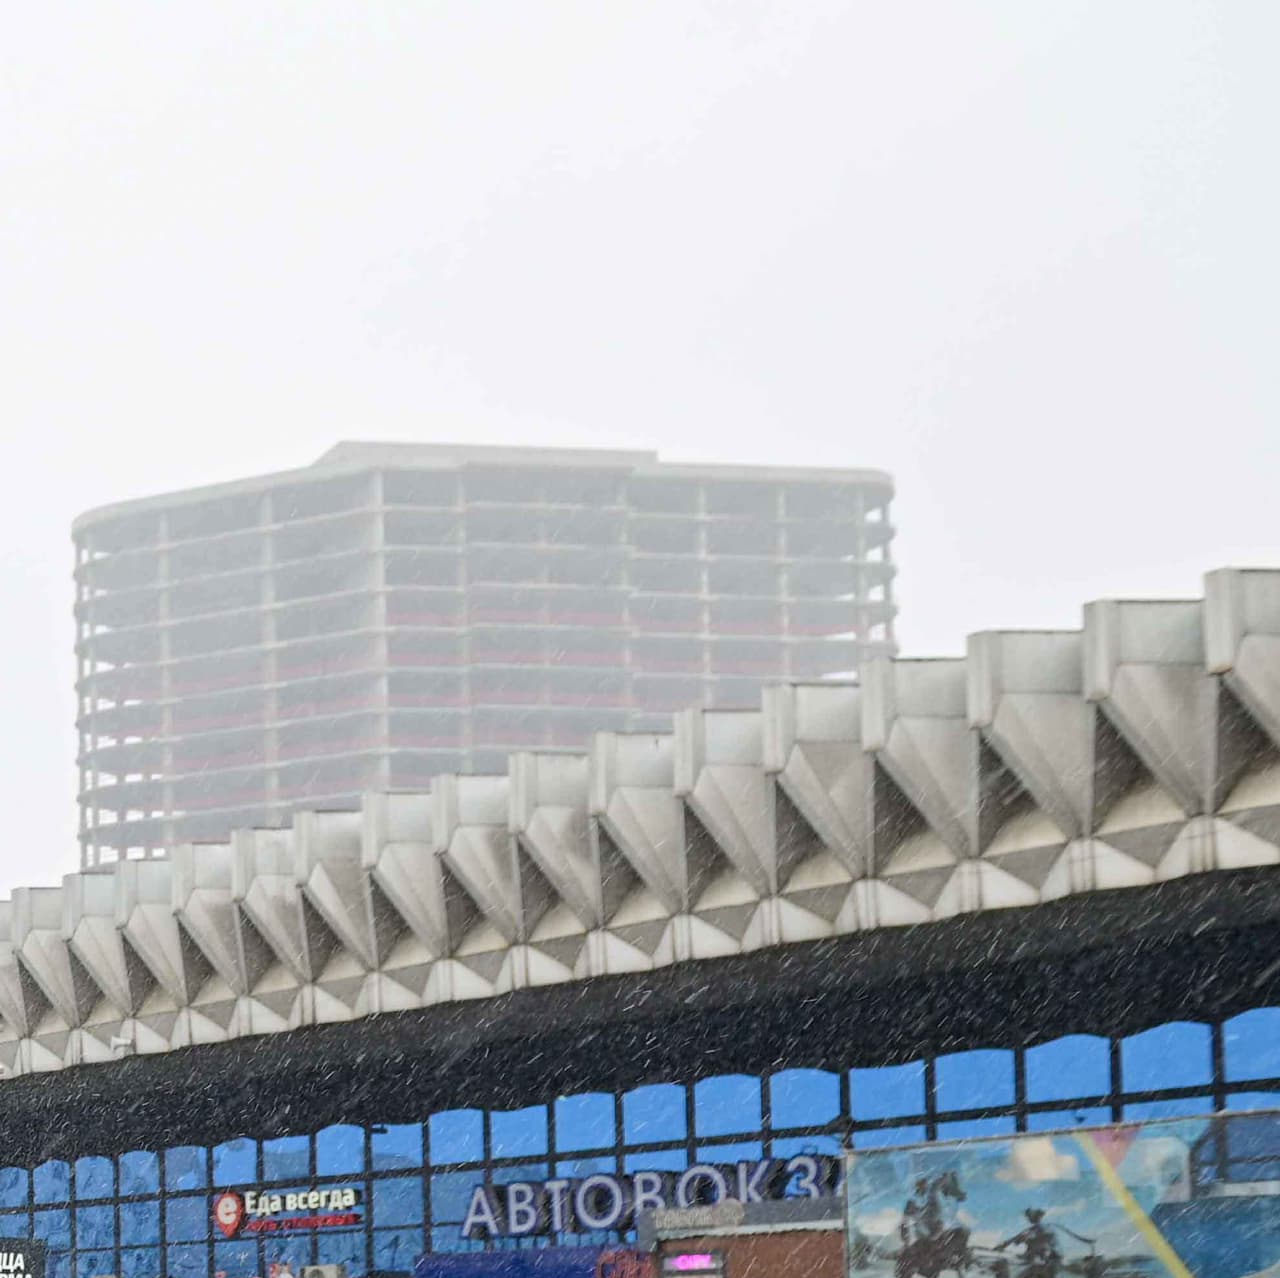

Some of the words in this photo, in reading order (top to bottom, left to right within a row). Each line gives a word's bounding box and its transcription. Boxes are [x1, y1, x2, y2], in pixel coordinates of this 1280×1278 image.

[245, 1191, 282, 1217] Еда
[285, 1188, 356, 1212] всегда
[461, 1155, 846, 1238] АВТОВОКЗ
